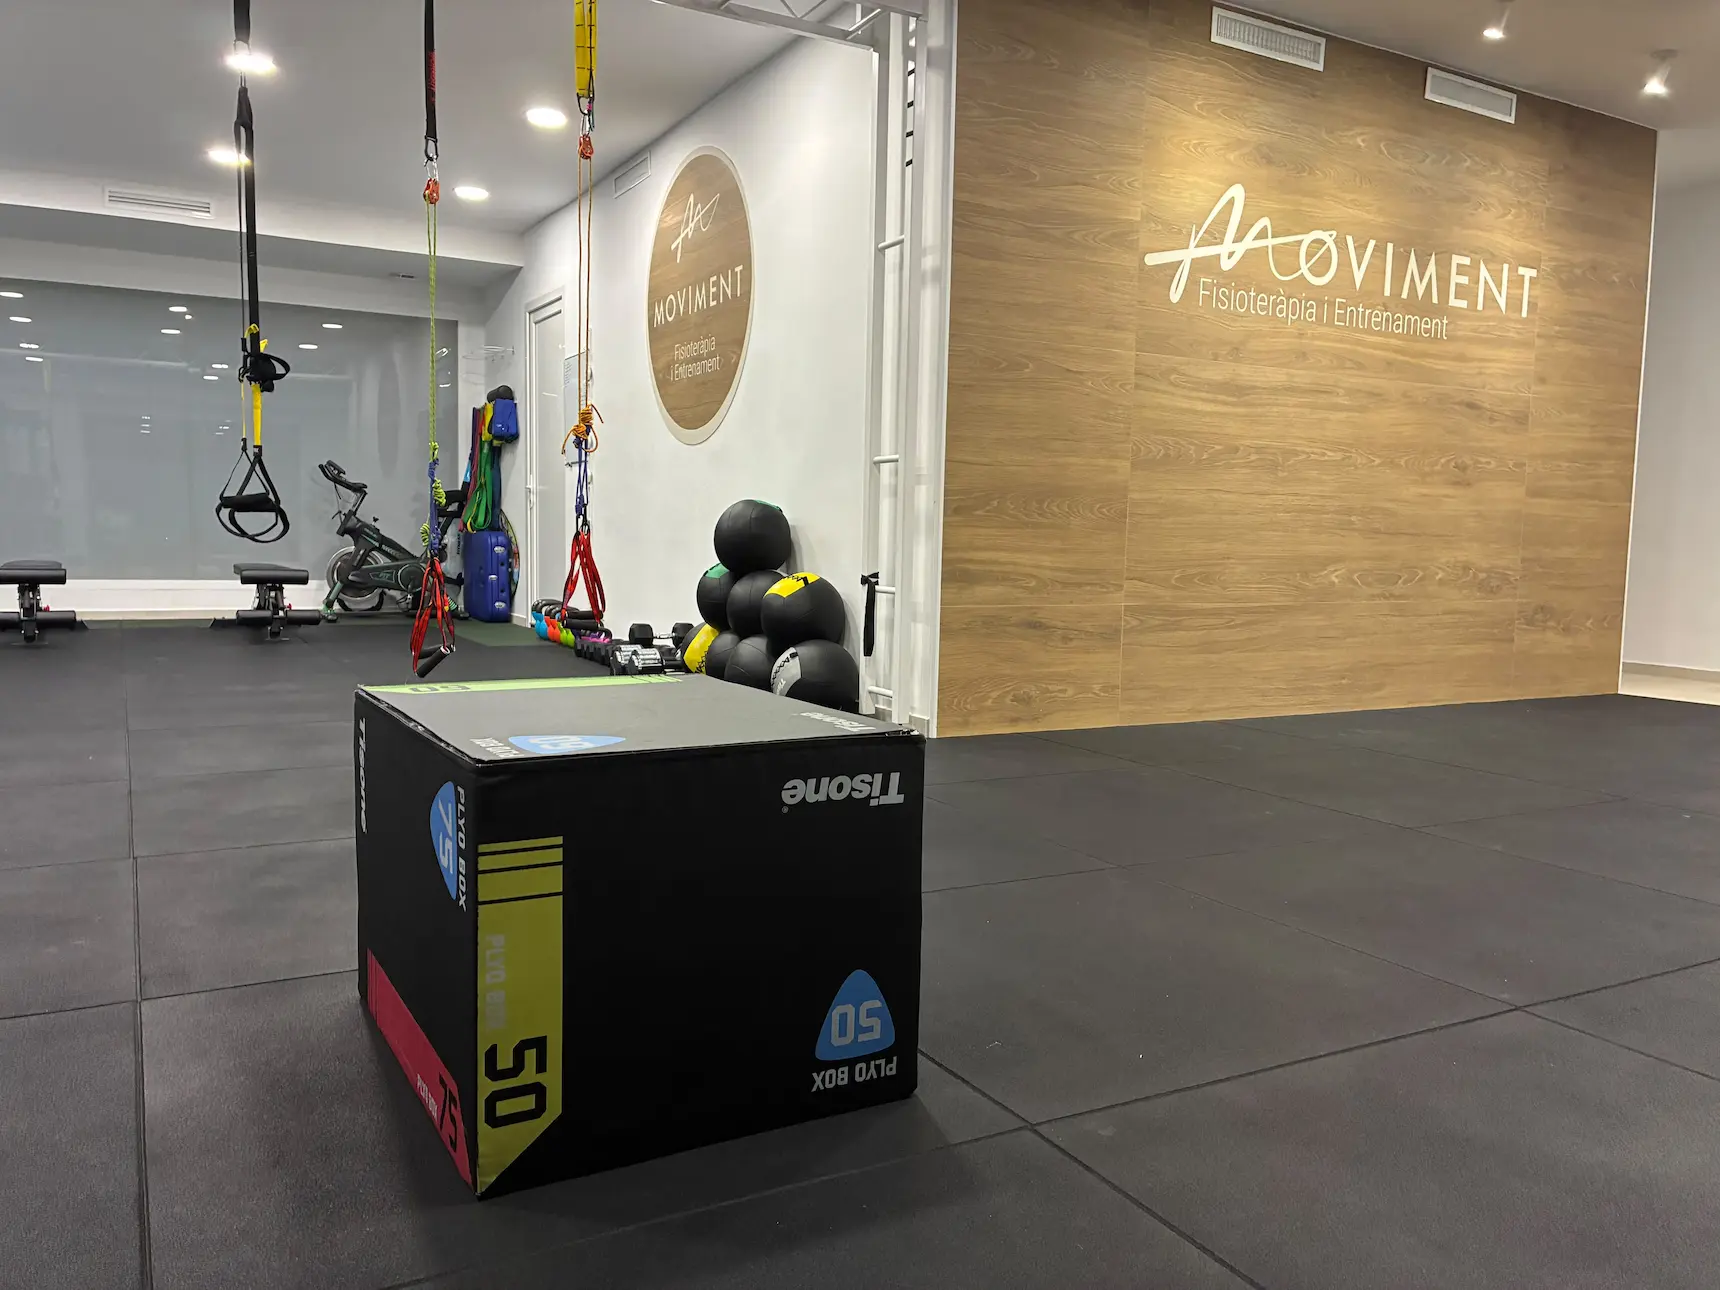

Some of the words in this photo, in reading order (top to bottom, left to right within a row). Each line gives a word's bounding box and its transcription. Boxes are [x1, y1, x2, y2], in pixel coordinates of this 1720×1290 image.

[1144, 183, 1538, 318] MOVIMENT
[653, 264, 744, 328] MOVIMENT
[1198, 278, 1317, 326] Fisioteràpia
[1322, 296, 1328, 324] i
[1334, 298, 1449, 340] Entrenament
[674, 334, 716, 361] Fisioteràpia
[674, 354, 720, 381] Entrenament
[358, 717, 368, 834] Tisone
[781, 771, 905, 807] Tisone
[438, 799, 454, 875] 75
[456, 785, 466, 850] PLYO
[458, 855, 467, 912] BOX
[830, 999, 883, 1047] 50
[484, 1035, 547, 1129] 50
[810, 1066, 849, 1093] BOX
[854, 1055, 898, 1083] PLYO
[438, 1071, 458, 1153] 75
